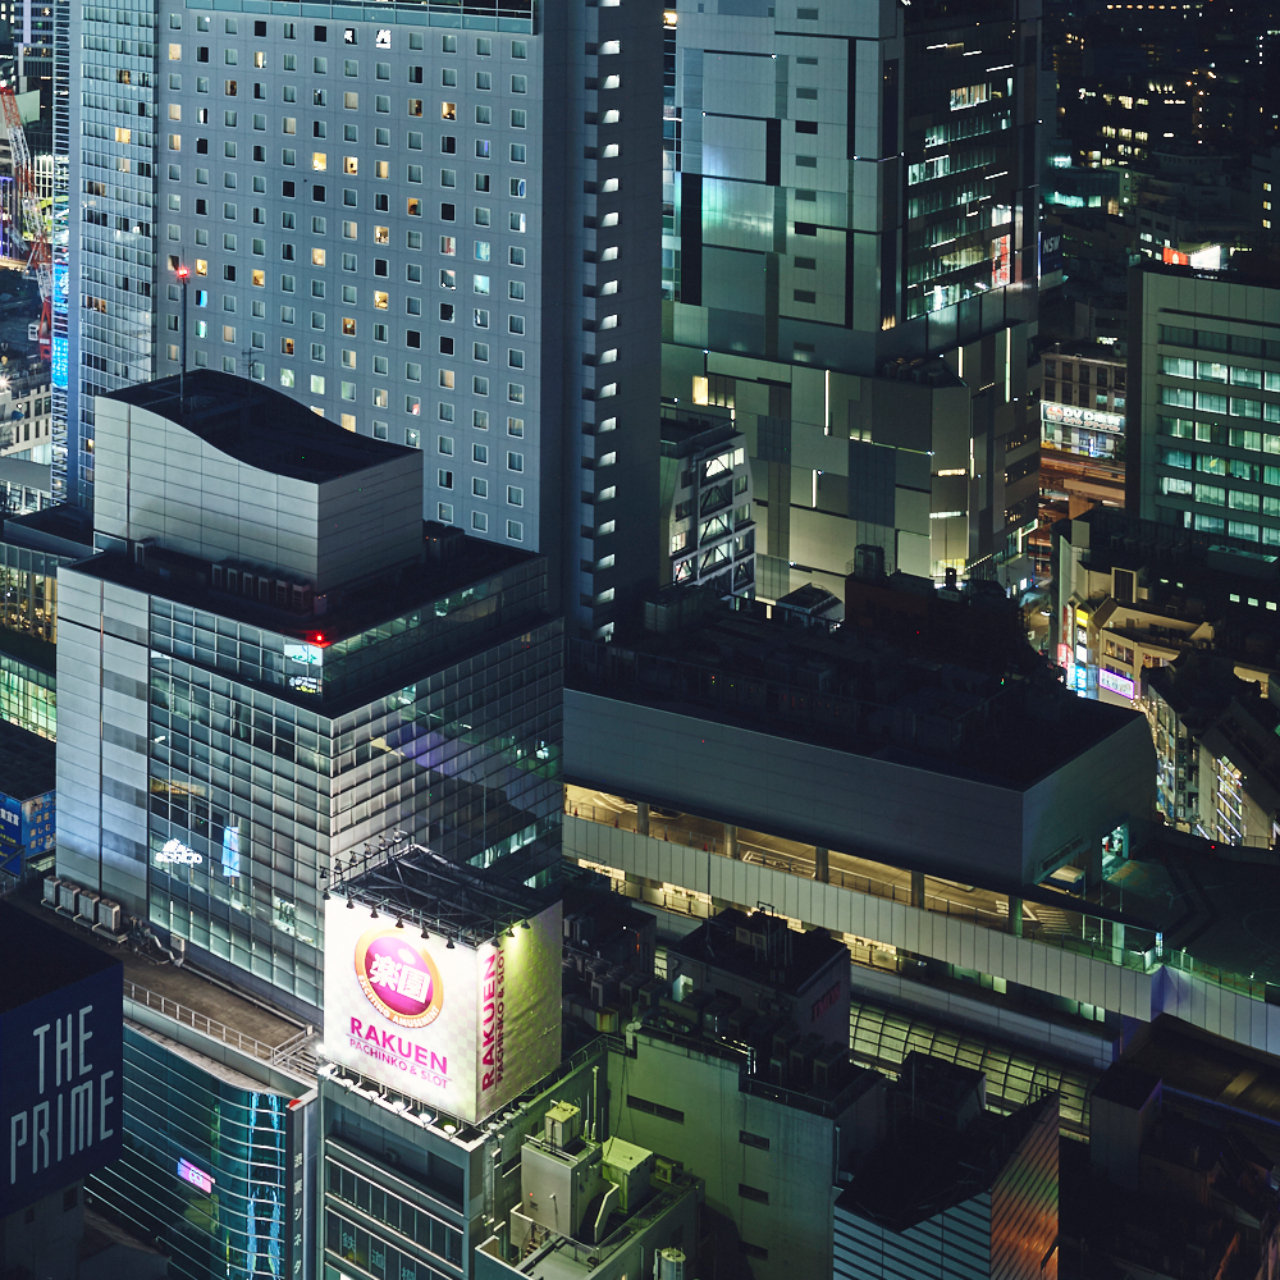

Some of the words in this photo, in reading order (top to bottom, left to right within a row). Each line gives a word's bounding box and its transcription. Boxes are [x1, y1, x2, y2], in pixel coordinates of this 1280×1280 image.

[357, 974, 391, 1022] EXCITING
[369, 952, 432, 1005] 楽園
[32, 1004, 94, 1095] THE
[350, 1016, 449, 1076] RAKUEN
[482, 953, 496, 1092] RAKUEN
[349, 1038, 407, 1071] PACHINKO
[409, 1064, 417, 1076] &
[421, 1069, 448, 1090] SLOT
[10, 1070, 114, 1185] PRIME
